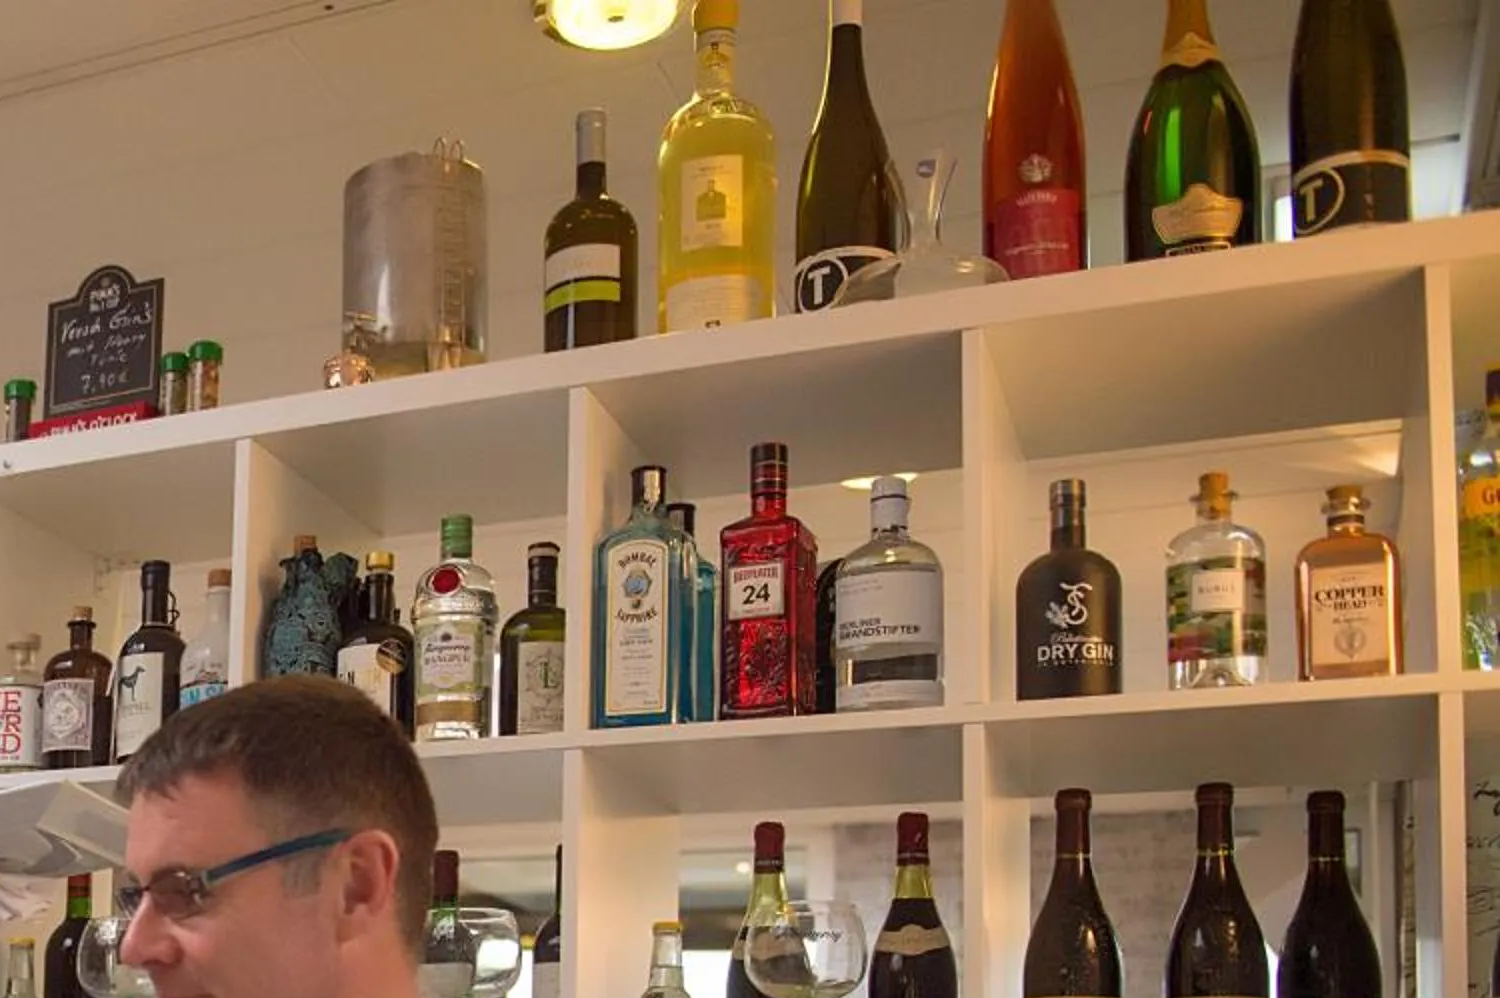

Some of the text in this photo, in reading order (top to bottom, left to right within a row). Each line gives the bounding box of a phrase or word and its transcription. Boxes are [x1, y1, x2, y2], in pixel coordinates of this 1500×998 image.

[1299, 177, 1324, 222] T
[807, 266, 831, 305] T
[742, 583, 771, 604] 24
[1315, 585, 1385, 606] COPPER
[1333, 600, 1367, 611] HEAD
[1037, 642, 1114, 662] DRY GIN
